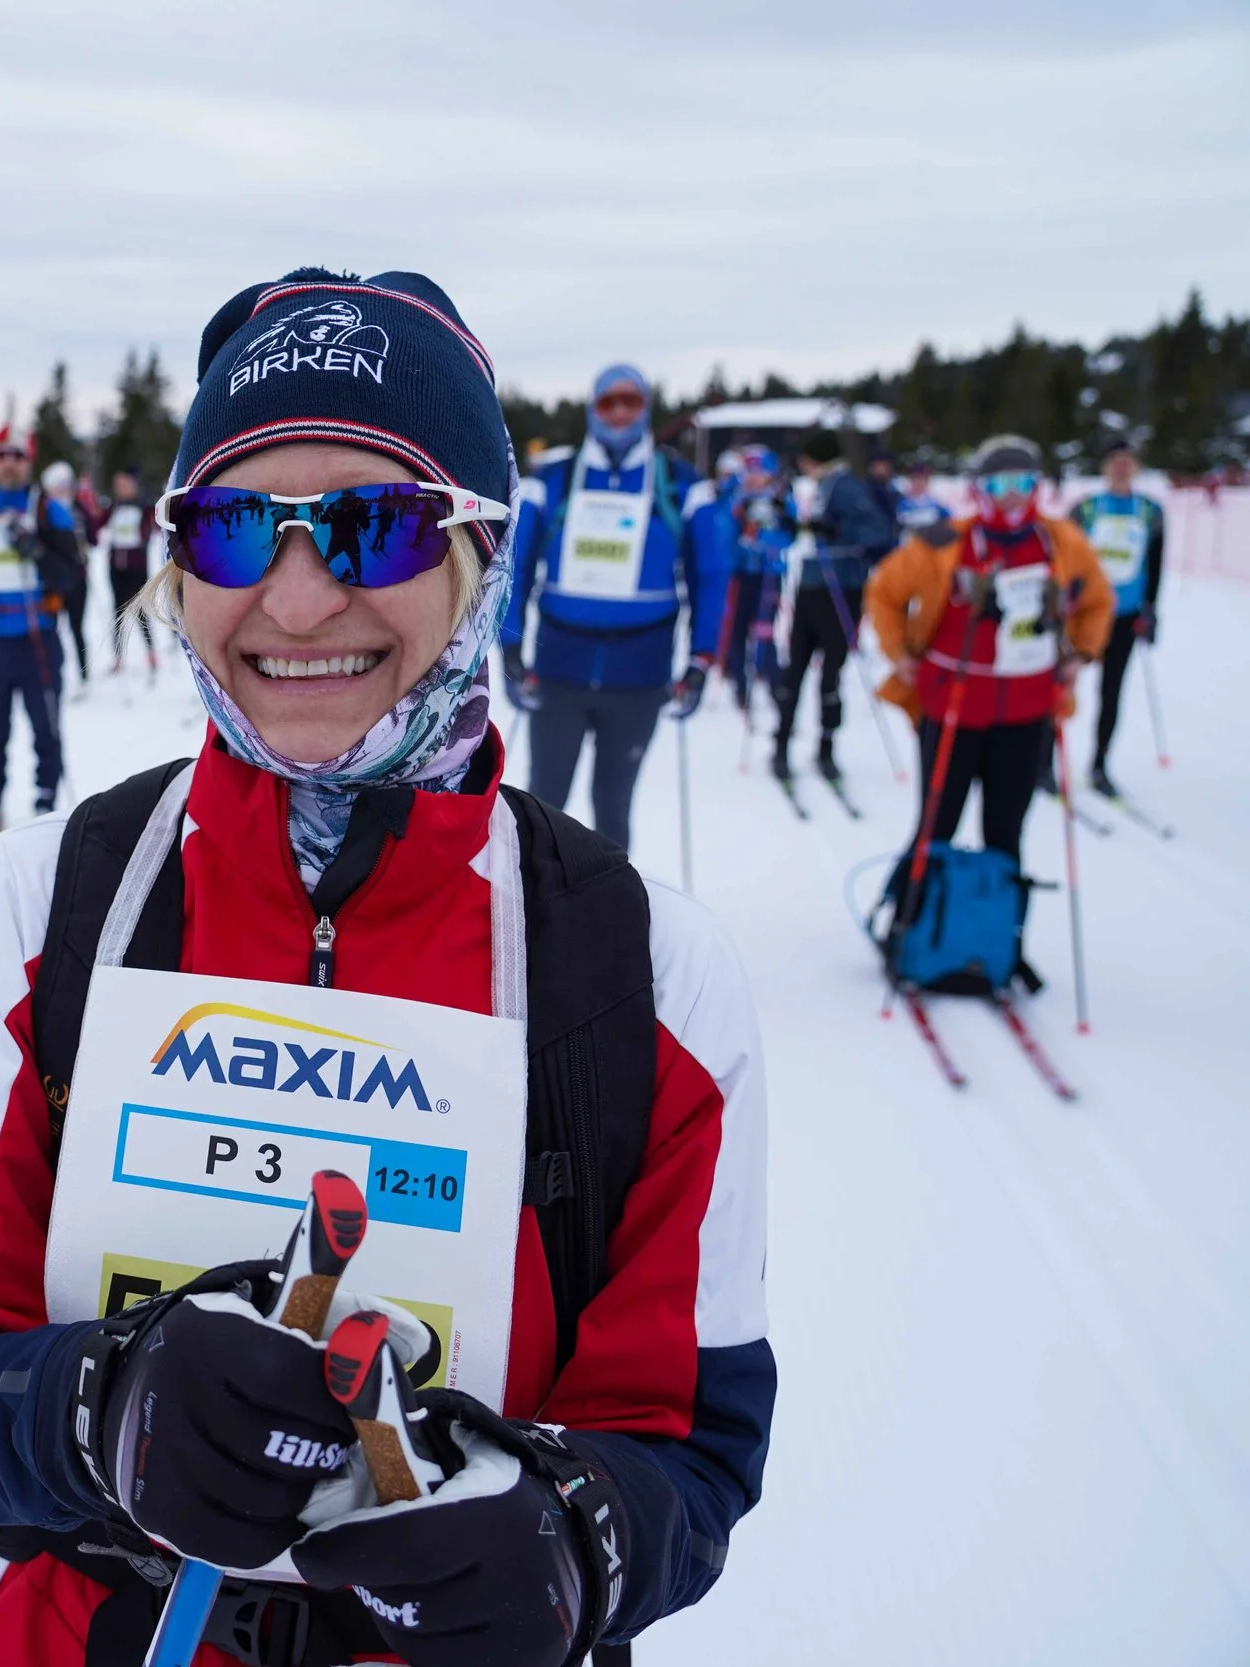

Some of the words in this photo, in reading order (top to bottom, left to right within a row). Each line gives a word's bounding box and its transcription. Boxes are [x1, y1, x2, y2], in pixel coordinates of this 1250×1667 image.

[229, 346, 385, 398] BIRKEN
[205, 1134, 239, 1175] P
[254, 1143, 282, 1184] 3
[374, 1166, 458, 1202] 12:10
[75, 1356, 121, 1506] LEKI
[143, 1391, 158, 1434] Legend
[133, 1478, 145, 1501] Slim
[593, 1503, 624, 1630] EKI
